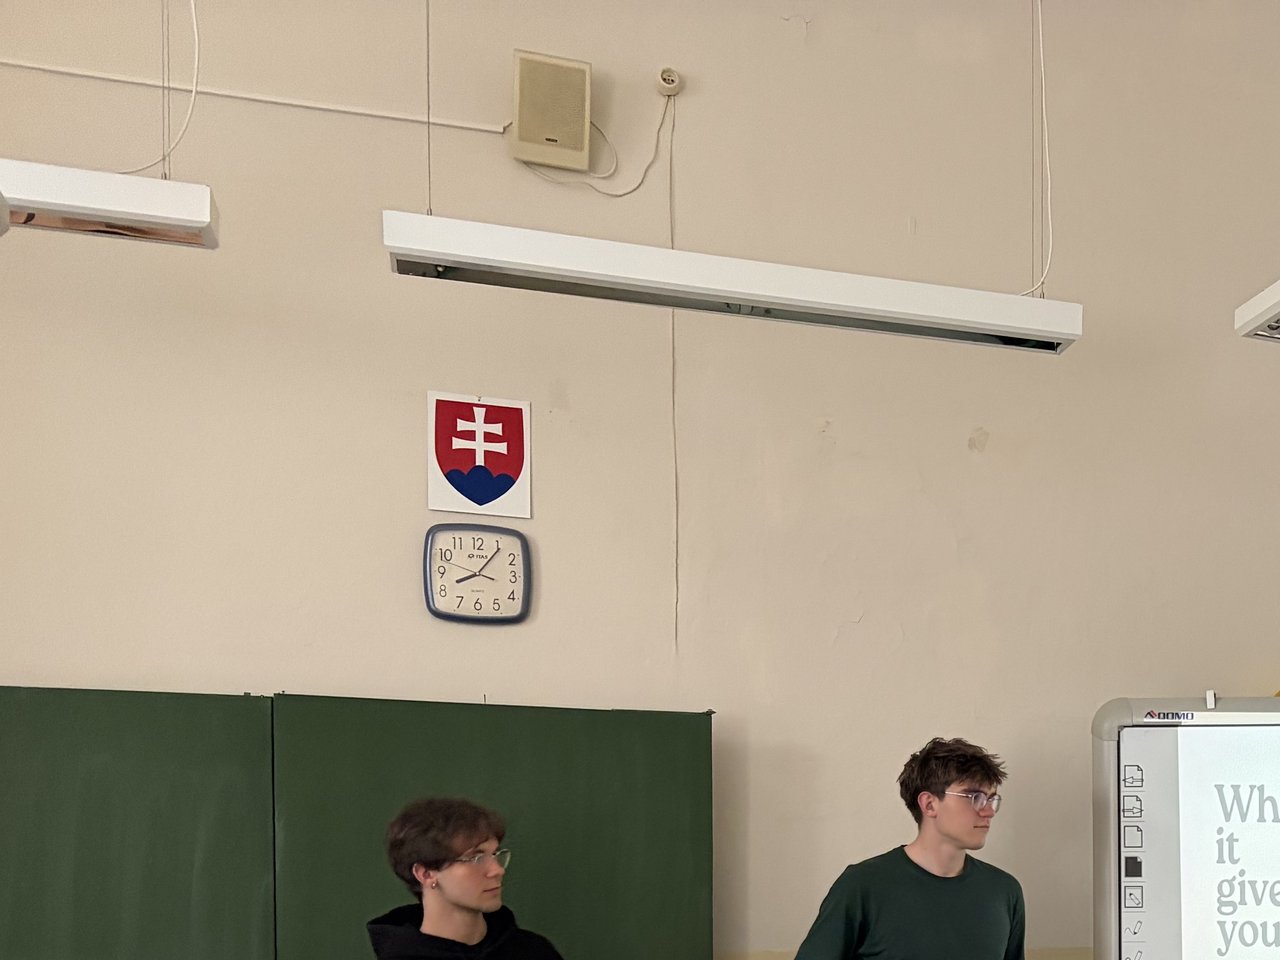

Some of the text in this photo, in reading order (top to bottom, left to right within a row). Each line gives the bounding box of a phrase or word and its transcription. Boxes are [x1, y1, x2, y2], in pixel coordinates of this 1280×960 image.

[452, 537, 462, 550] 11
[472, 537, 484, 551] 12
[439, 548, 516, 566] 10 2
[438, 565, 518, 584] 9 3
[439, 584, 516, 602] 8 4
[456, 596, 501, 612] 7 6 5
[1216, 826, 1241, 865] it
